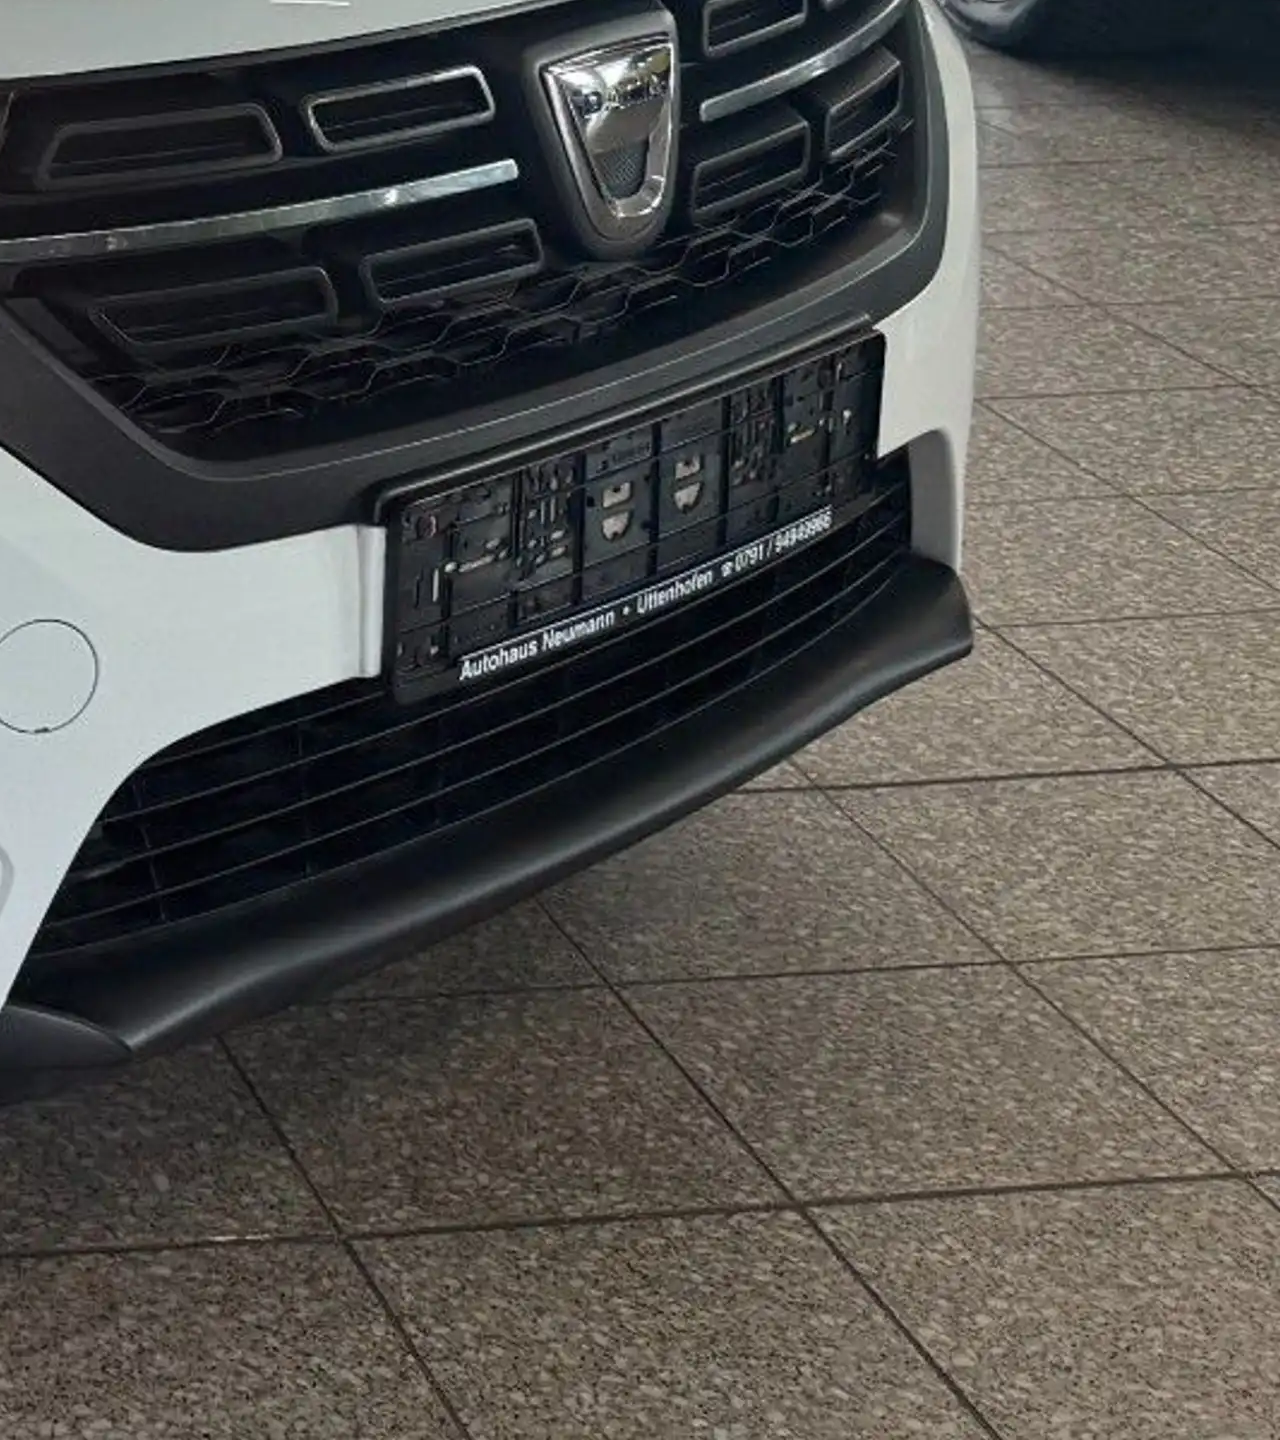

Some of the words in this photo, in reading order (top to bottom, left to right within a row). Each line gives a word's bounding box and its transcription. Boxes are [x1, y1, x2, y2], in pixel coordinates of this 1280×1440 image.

[459, 639, 538, 681] Autohaus
[542, 610, 615, 652] Neumann
[637, 570, 714, 615] Uttenhofen
[734, 543, 764, 572] 0791
